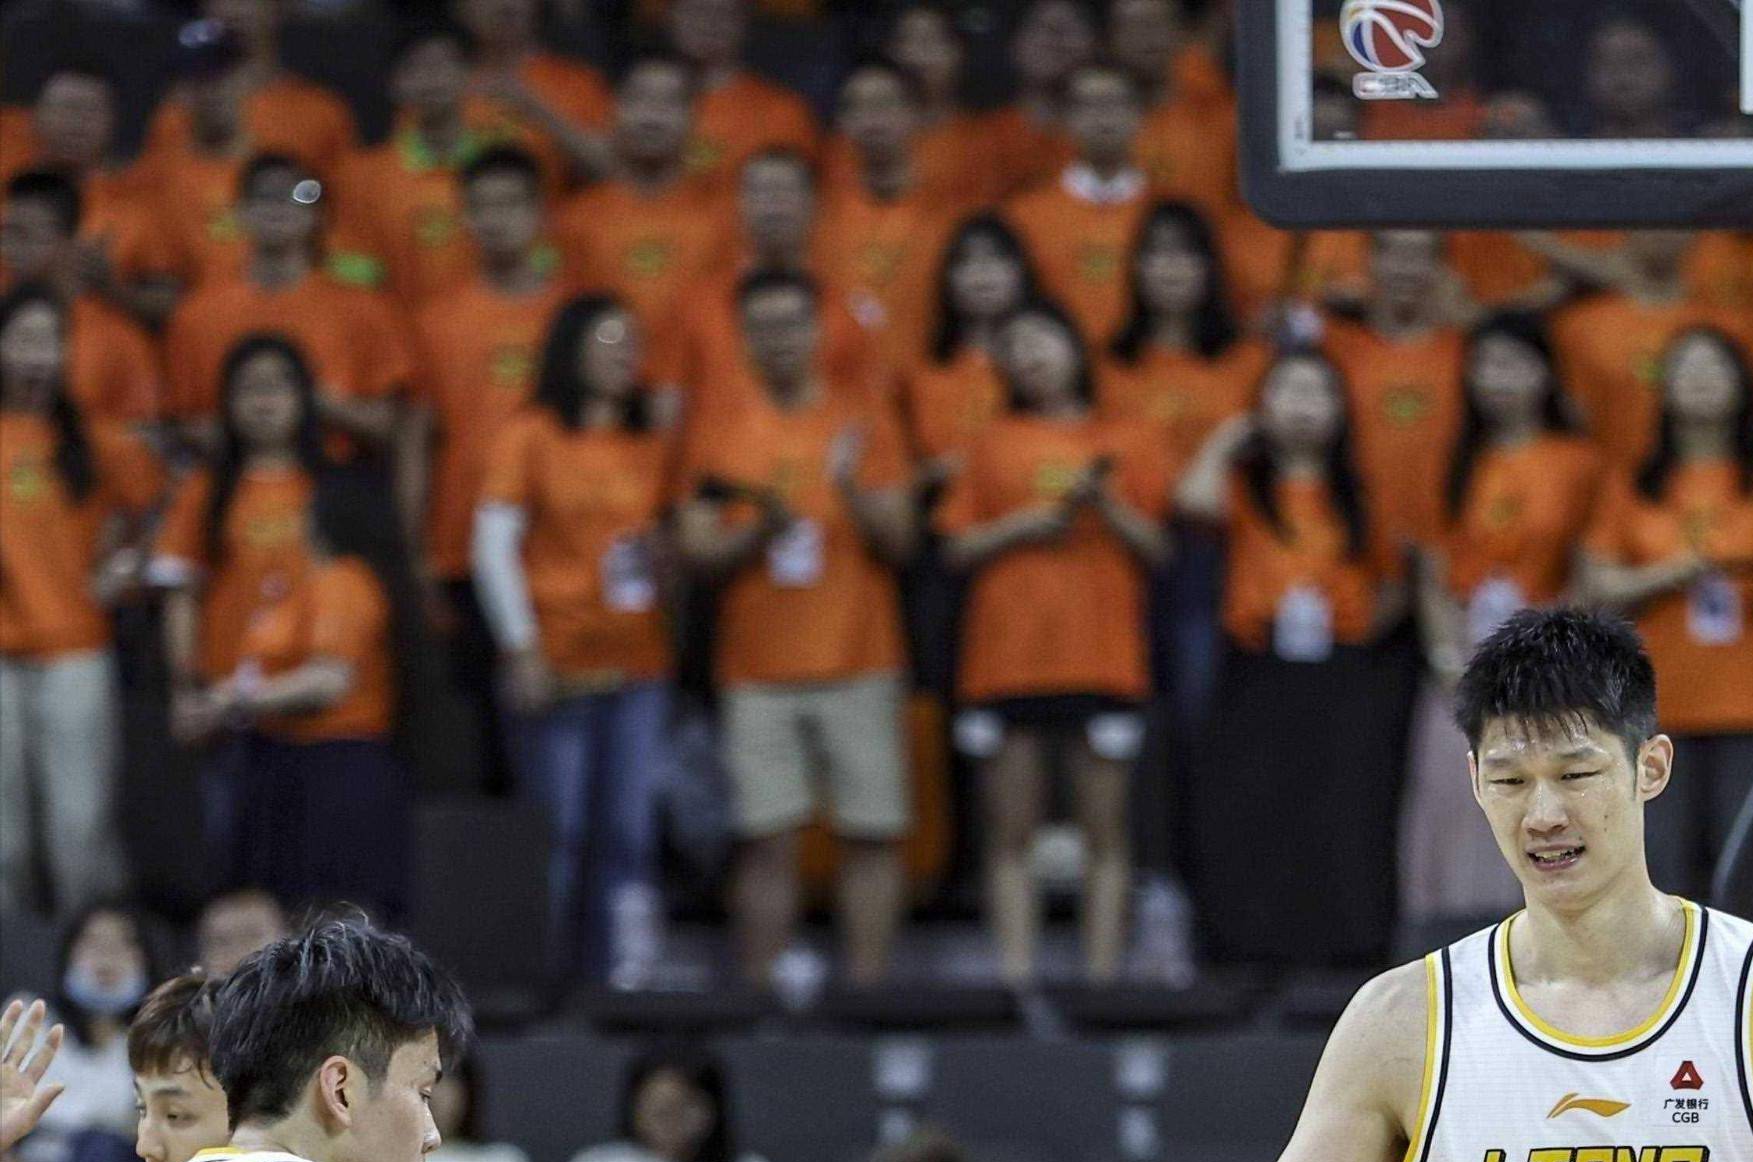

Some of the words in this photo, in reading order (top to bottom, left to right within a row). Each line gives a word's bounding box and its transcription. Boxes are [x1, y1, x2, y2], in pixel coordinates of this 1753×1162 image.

[1663, 1098, 1709, 1110] 广发银行
[1672, 1111, 1700, 1123] CGB
